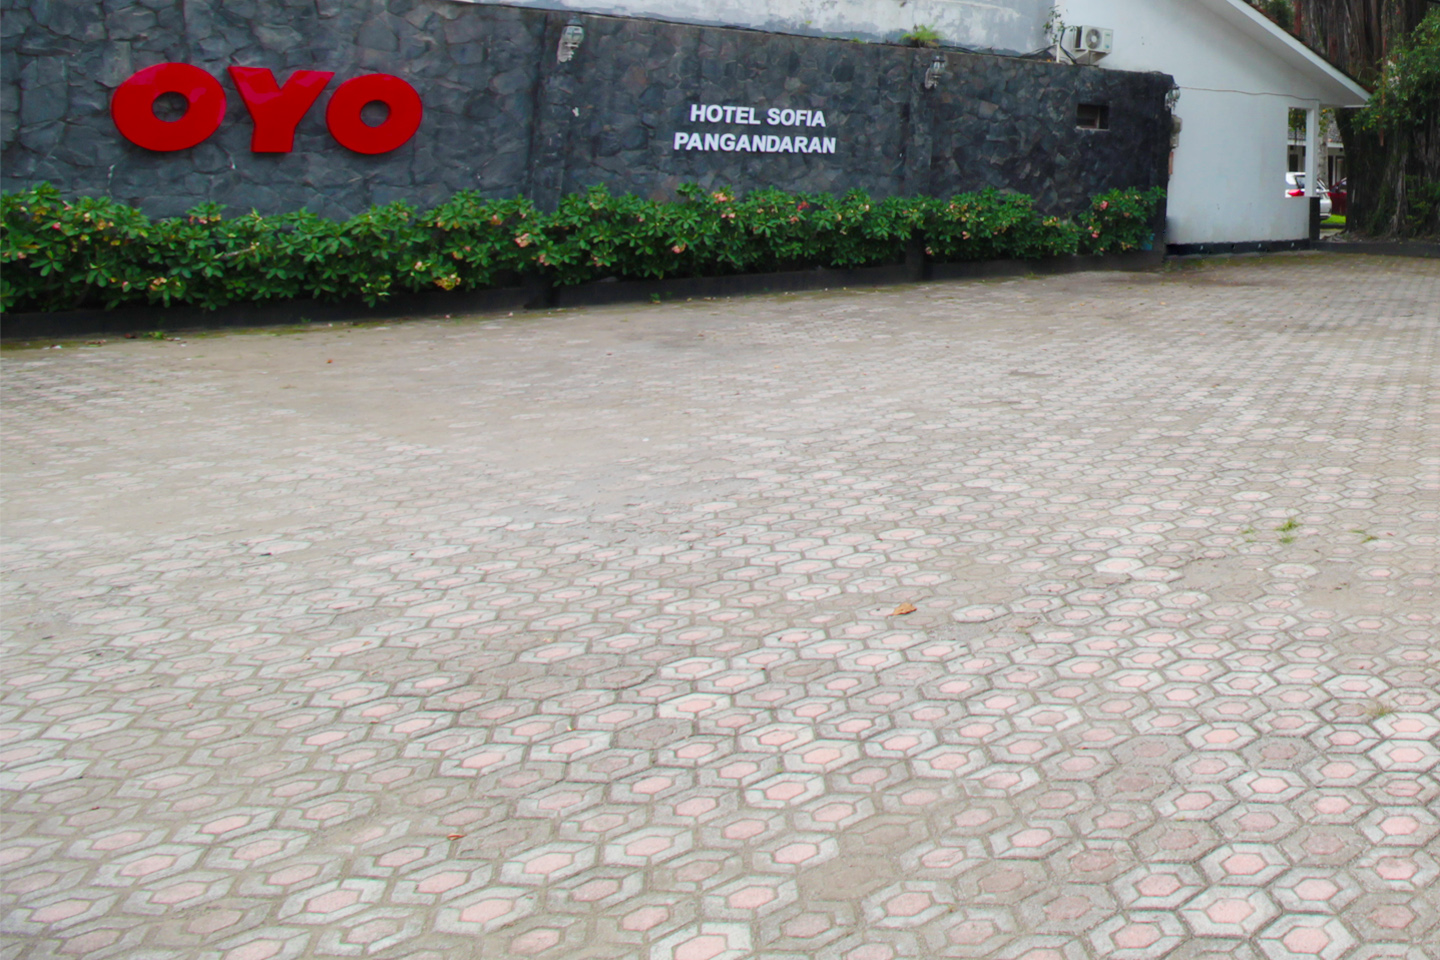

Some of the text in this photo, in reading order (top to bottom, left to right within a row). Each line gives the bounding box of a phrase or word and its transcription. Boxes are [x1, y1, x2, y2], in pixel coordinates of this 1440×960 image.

[111, 62, 423, 155] OYO
[690, 104, 826, 127] HOTEL SOFIA
[673, 132, 837, 154] PANGANDARAN
